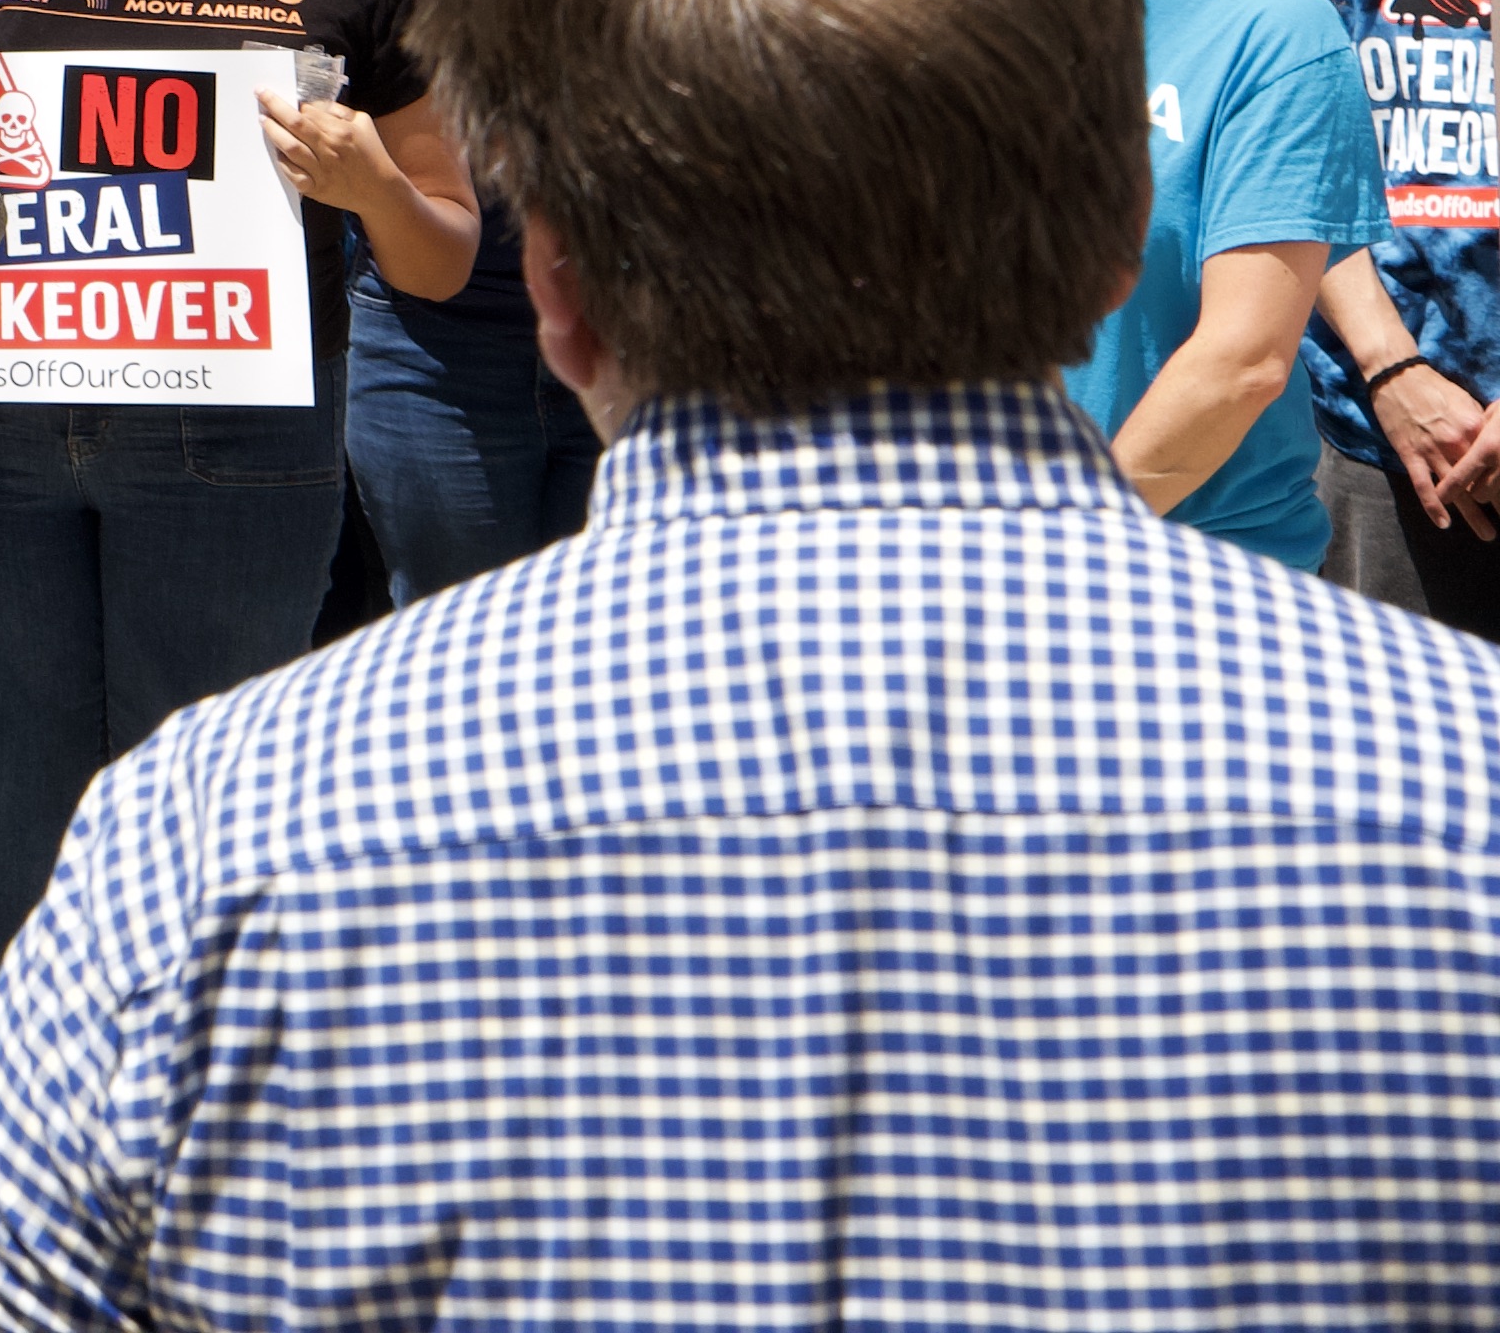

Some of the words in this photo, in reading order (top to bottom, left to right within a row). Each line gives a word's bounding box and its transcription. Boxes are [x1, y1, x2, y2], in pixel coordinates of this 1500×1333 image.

[195, 2, 303, 26] AMERICA
[79, 74, 198, 170] NO
[4, 183, 181, 258] ERAL
